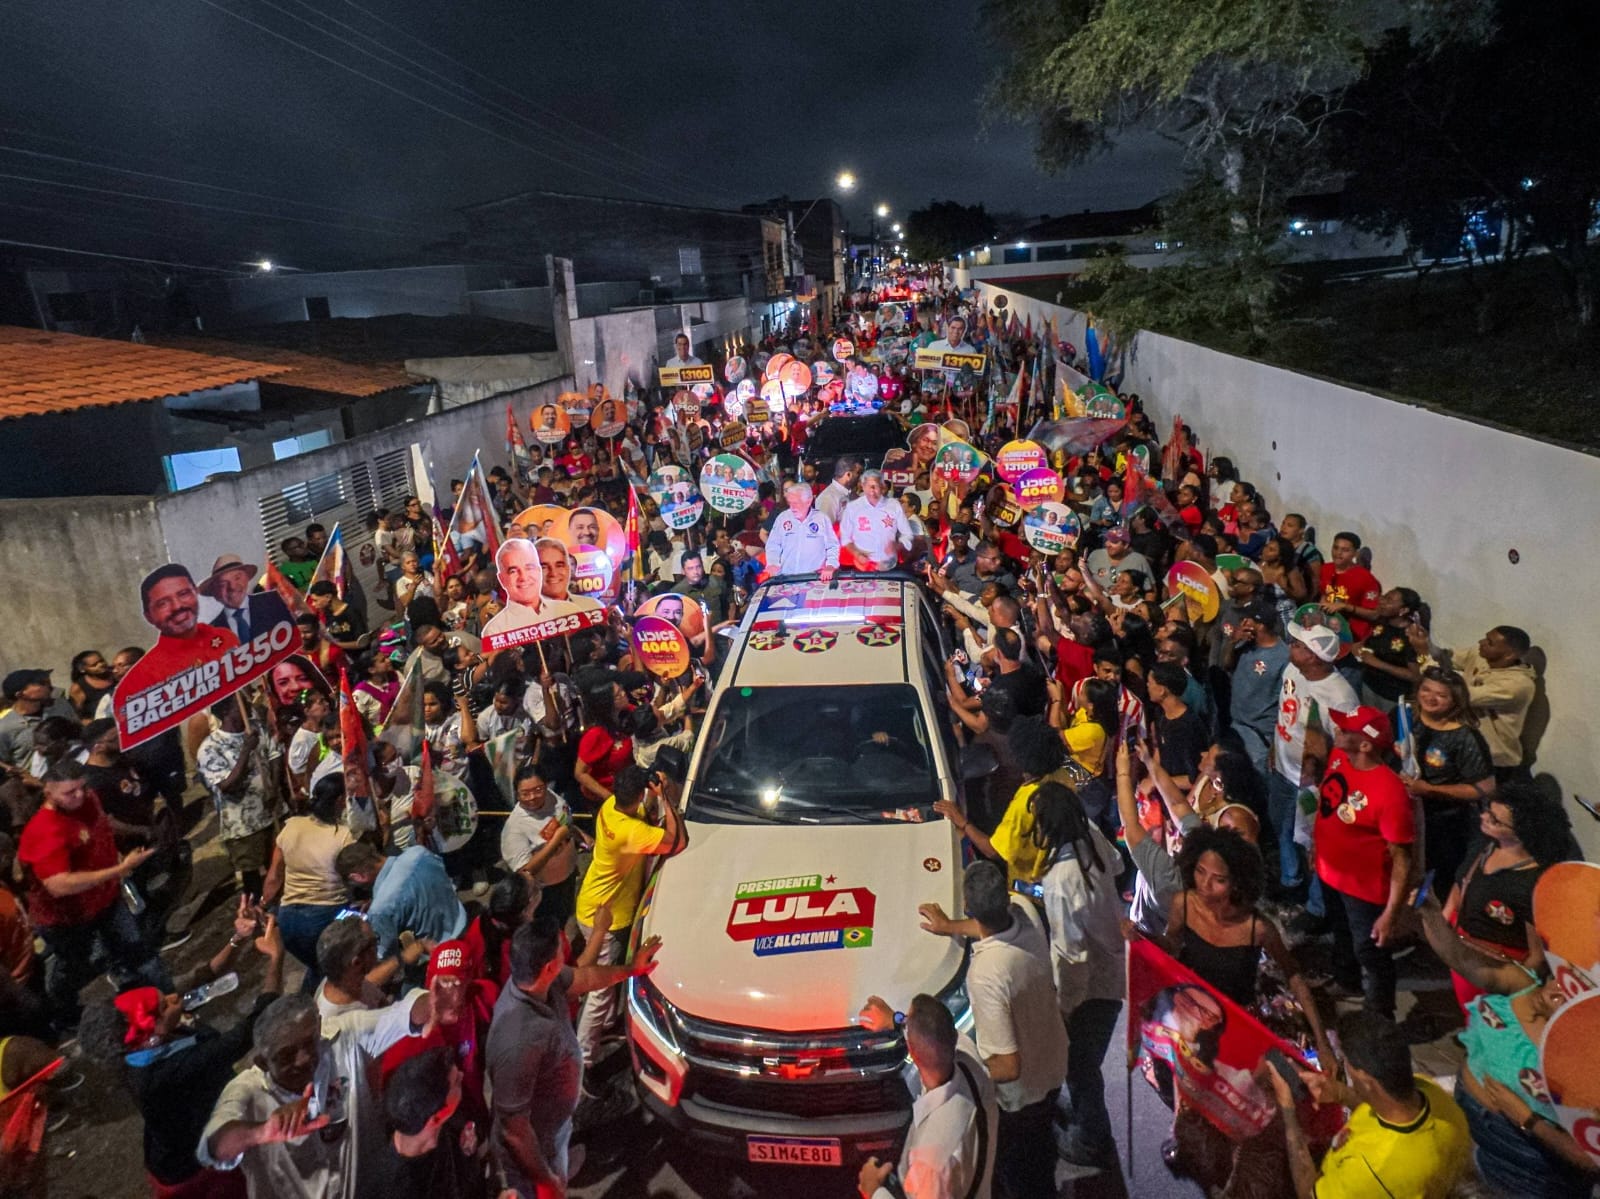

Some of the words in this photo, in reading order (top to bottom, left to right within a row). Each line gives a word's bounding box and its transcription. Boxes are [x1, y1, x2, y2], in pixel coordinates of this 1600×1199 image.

[681, 368, 711, 380] 13100
[722, 488, 744, 498] NETO
[1021, 485, 1059, 497] 4040
[711, 495, 745, 511] 1323
[673, 514, 697, 527] 1323
[507, 626, 538, 640] NETO
[538, 614, 581, 637] 1323
[642, 640, 681, 653] 4040
[809, 637, 822, 645] 13
[220, 620, 293, 683] 1350
[126, 660, 220, 719] DEYVID
[127, 675, 221, 734] BACELAR
[738, 875, 818, 895] PRESIDENTE
[731, 892, 861, 926] LULA
[756, 936, 774, 951] VICE
[774, 930, 839, 948] ALCKMIN
[437, 958, 462, 969] NIMO
